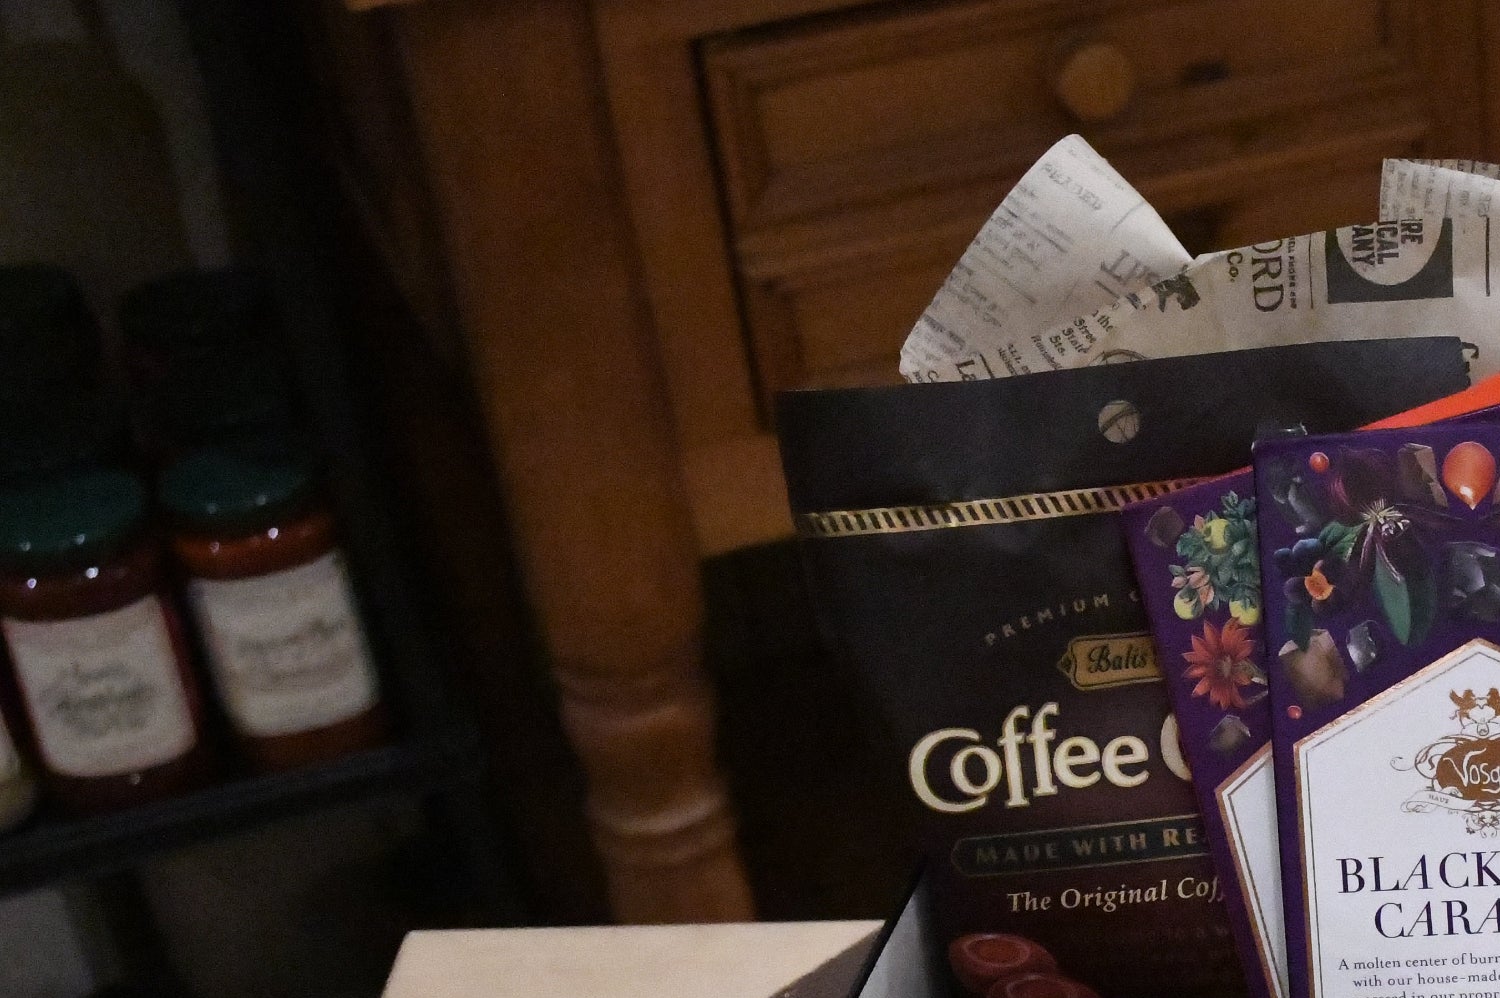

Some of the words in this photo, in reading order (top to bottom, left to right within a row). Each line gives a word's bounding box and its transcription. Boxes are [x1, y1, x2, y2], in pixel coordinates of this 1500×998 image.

[1226, 251, 1243, 282] Co.
[983, 592, 1110, 648] PREMIUM
[908, 702, 1150, 813] Coffee
[976, 842, 1059, 864] MADE
[1072, 833, 1147, 857] WITH
[1162, 827, 1208, 847] RE
[1007, 891, 1052, 913] The
[1060, 879, 1169, 912] Original
[1338, 958, 1350, 971] A
[1353, 955, 1402, 970] molten
[1405, 954, 1447, 968] center
[1451, 952, 1467, 966] of
[1353, 973, 1384, 988] with
[1387, 975, 1413, 986] our
